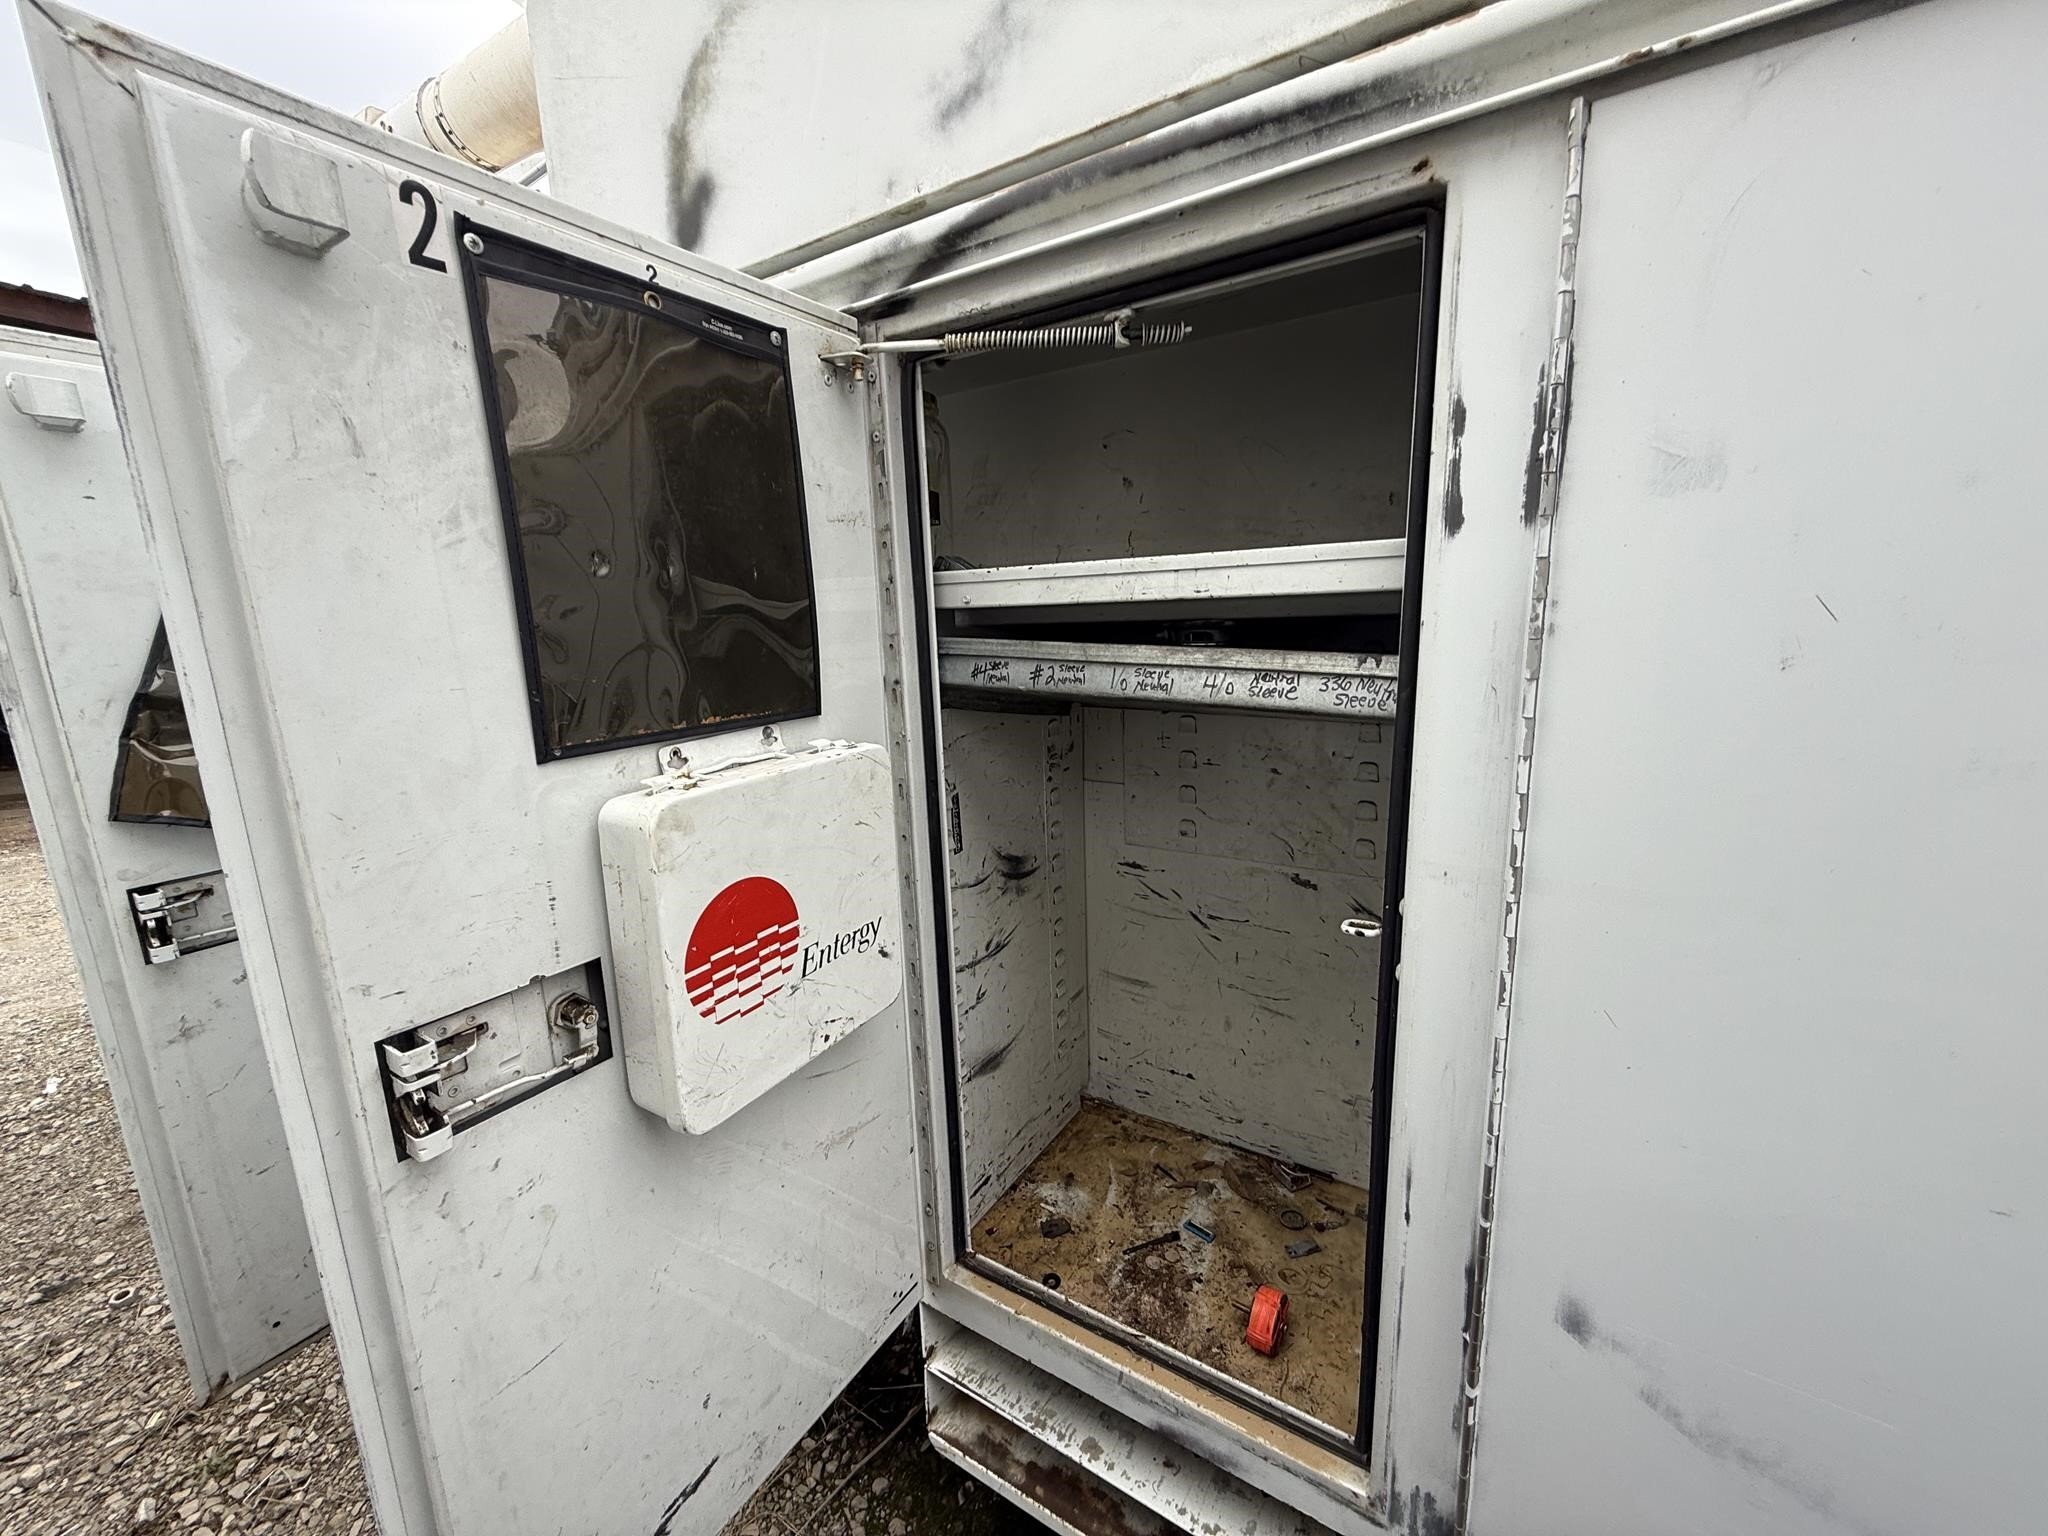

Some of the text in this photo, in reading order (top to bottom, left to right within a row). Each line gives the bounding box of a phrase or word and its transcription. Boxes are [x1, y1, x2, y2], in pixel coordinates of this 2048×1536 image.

[399, 179, 448, 274] 2
[645, 264, 660, 286] 2
[1318, 675, 1351, 693] 336
[801, 916, 882, 980] Entergy
